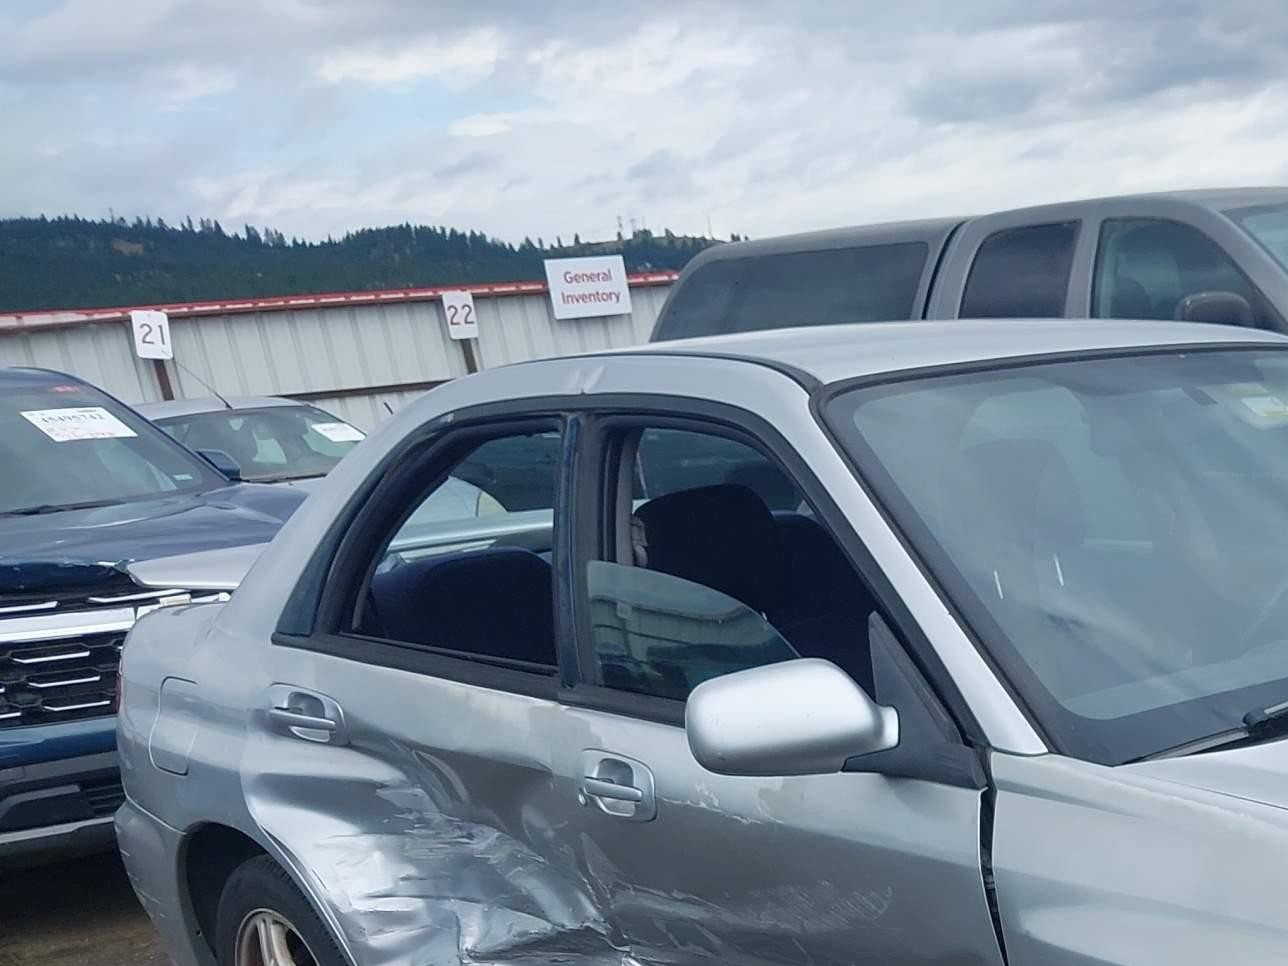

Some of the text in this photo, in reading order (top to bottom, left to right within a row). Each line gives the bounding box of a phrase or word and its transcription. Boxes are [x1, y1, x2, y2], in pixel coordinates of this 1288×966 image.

[563, 269, 613, 284] General
[561, 291, 621, 304] Inventory
[447, 304, 475, 325] 22
[139, 323, 166, 345] 21
